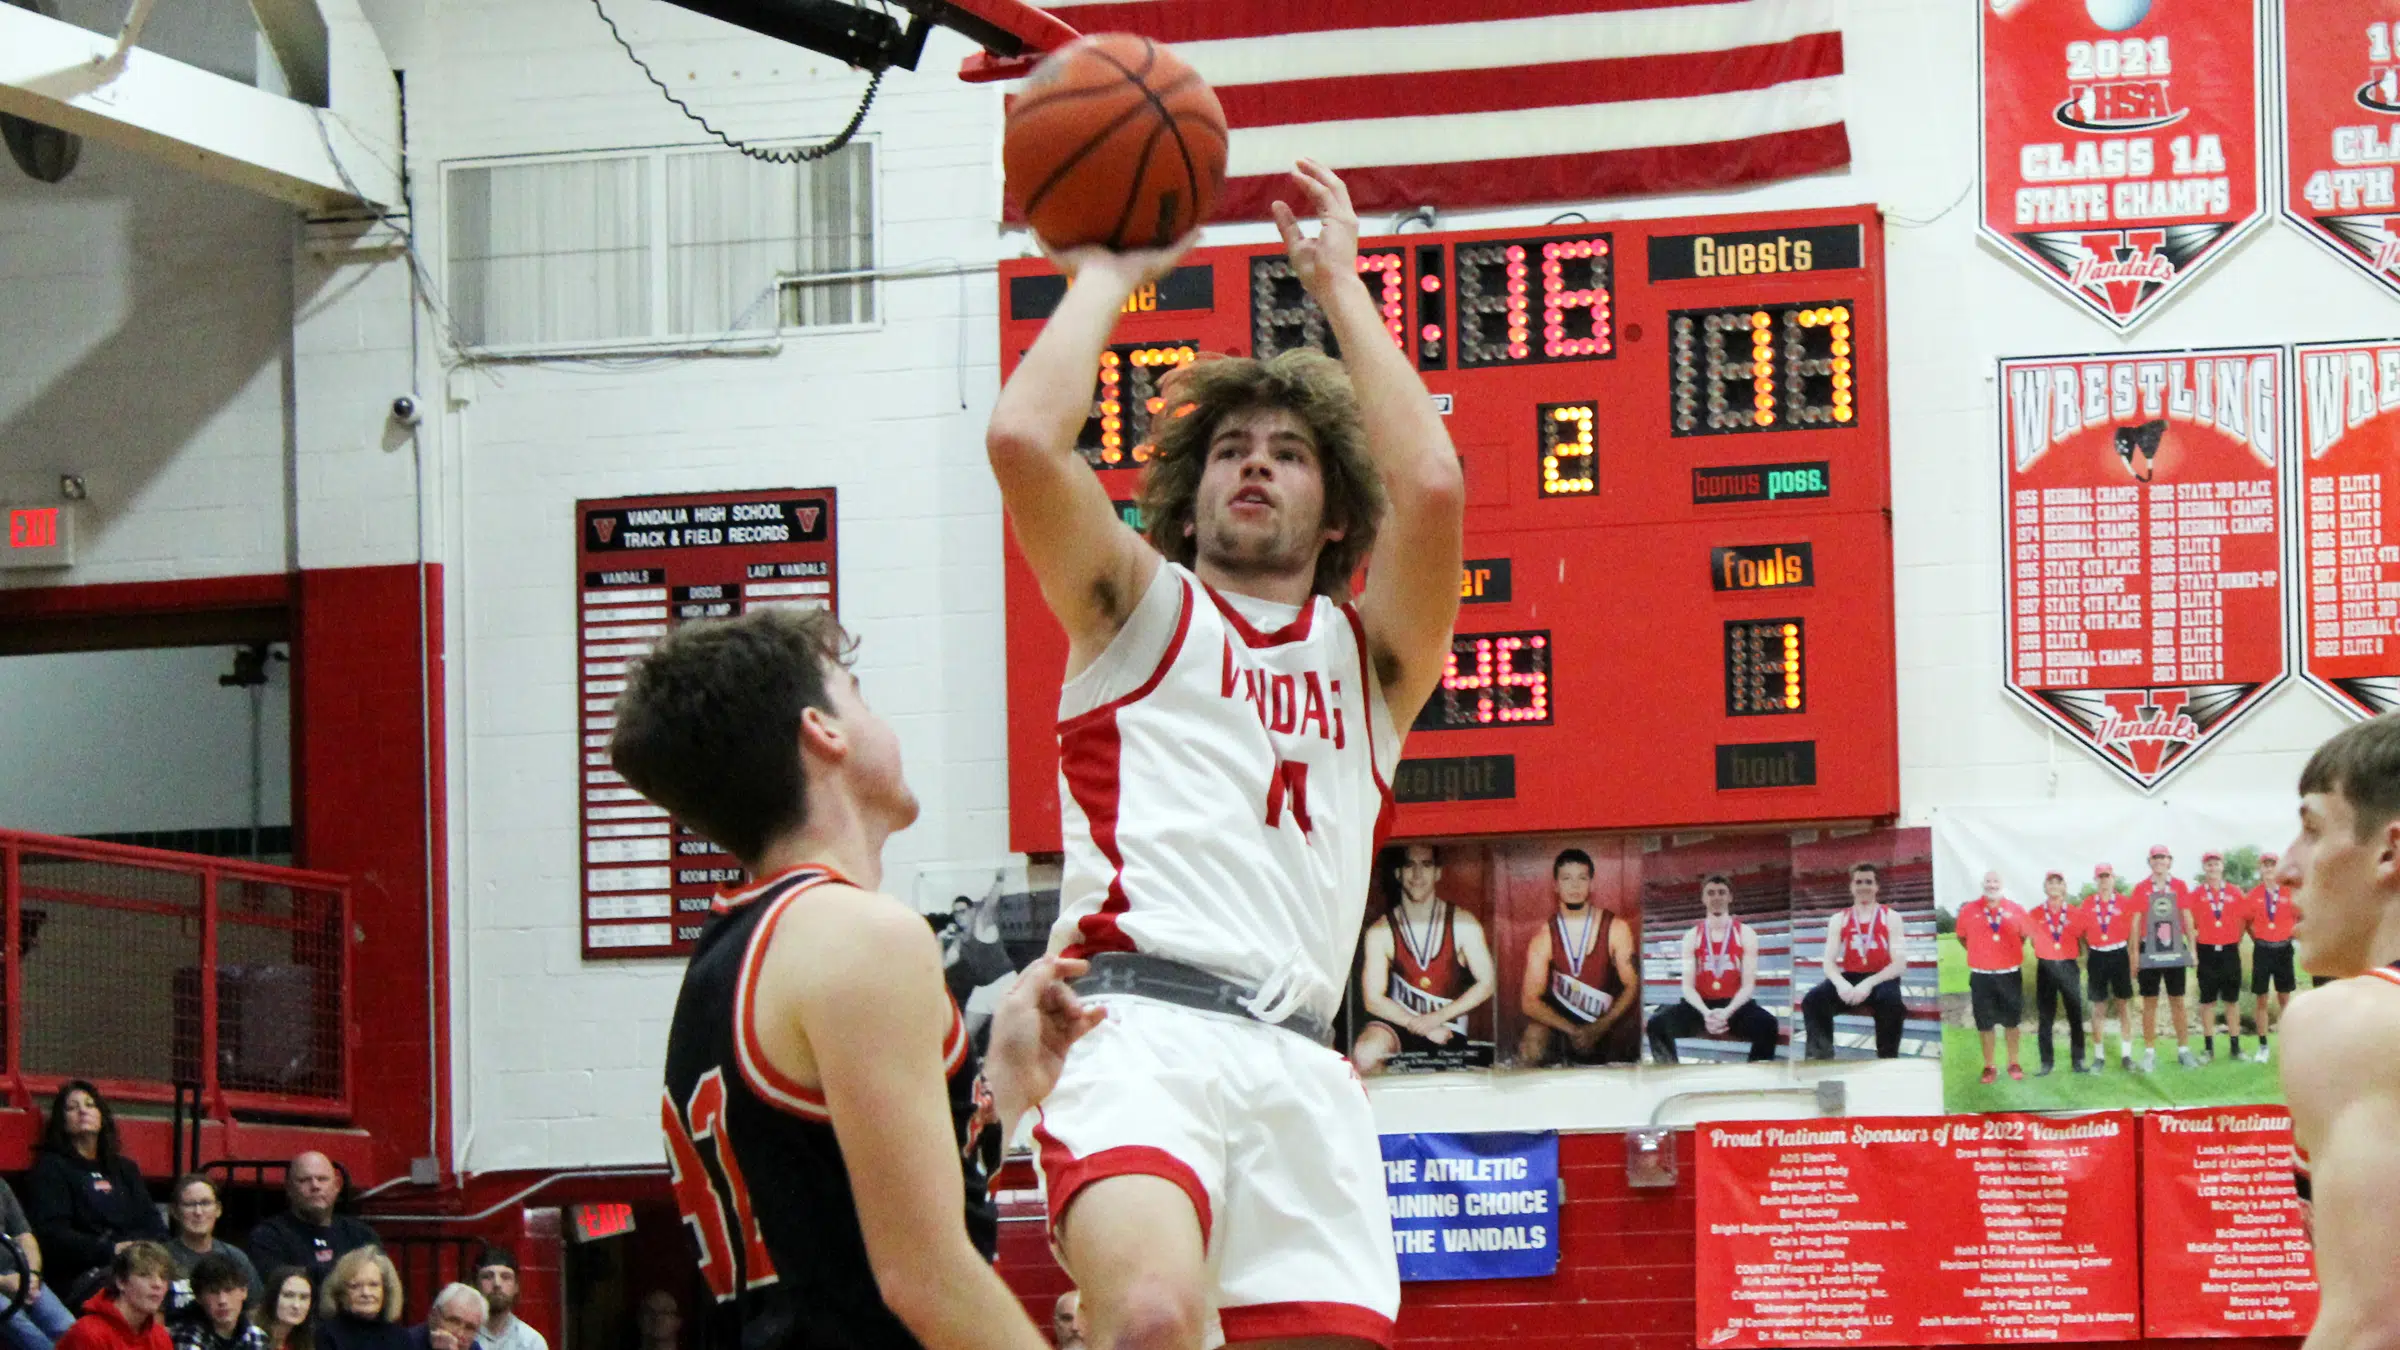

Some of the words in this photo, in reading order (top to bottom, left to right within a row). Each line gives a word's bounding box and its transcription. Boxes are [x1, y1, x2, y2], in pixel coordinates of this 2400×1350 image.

[2066, 36, 2170, 80] 2021
[2020, 137, 2154, 181] CLASS
[2170, 134, 2226, 173] 1A
[2304, 167, 2394, 210] 4TH
[2016, 183, 2108, 224] STATE
[2114, 177, 2229, 219] CHAMPS
[1694, 235, 1813, 276] Guests
[2070, 253, 2177, 287] Vandals
[1751, 305, 1853, 426] 17
[2010, 357, 2277, 473] WRESTLING
[1543, 405, 1594, 493] 2
[1695, 469, 1760, 497] bonus
[1768, 465, 1827, 500] poss.
[2178, 483, 2212, 499] STATE
[2238, 481, 2271, 496] PLACE
[2340, 474, 2371, 492] ELITE
[2097, 486, 2139, 502] CHAMPS
[2341, 494, 2371, 510] ELITE
[627, 507, 688, 526] VANDALIA
[694, 505, 726, 523] HIGH
[732, 504, 784, 522] SCHOOL
[2097, 505, 2139, 520] CHAMPS
[2232, 499, 2272, 515] CHAMPS
[10, 508, 59, 548] EXIT
[2232, 517, 2273, 533] CHAMPS
[2341, 512, 2371, 528] ELITE
[624, 531, 666, 548] TRACK
[670, 529, 680, 546] &
[684, 528, 722, 545] FIELD
[729, 525, 789, 543] RECORDS
[2098, 523, 2139, 538] CHAMPS
[2341, 530, 2372, 546] ELITE
[2098, 541, 2139, 556] CHAMPS
[2180, 538, 2210, 553] ELITE
[2180, 556, 2210, 571] ELITE
[2342, 548, 2375, 564] STATE
[747, 564, 774, 578] LADY
[779, 562, 827, 576] VANDALS
[1723, 547, 1803, 589] fouls
[2045, 561, 2079, 576] STATE
[2107, 559, 2140, 574] PLACE
[2342, 566, 2374, 583] ELITE
[601, 570, 650, 584] VANDALS
[2180, 574, 2214, 589] STATE
[689, 586, 723, 599] DISCUS
[2045, 579, 2080, 594] STATE
[2083, 578, 2124, 593] CHAMPS
[2342, 584, 2374, 600] STATE
[2045, 597, 2080, 612] STATE
[2108, 595, 2140, 610] PLACE
[2181, 592, 2212, 607] ELITE
[2182, 610, 2212, 625] ELITE
[2343, 602, 2374, 618] STATE
[2046, 615, 2080, 630] STATE
[2108, 613, 2141, 629] PLACE
[2047, 633, 2077, 648] ELITE
[2181, 628, 2212, 644] ELITE
[2182, 647, 2212, 662] ELITE
[2344, 639, 2374, 655] ELITE
[2100, 649, 2142, 665] CHAMPS
[1783, 623, 1800, 709] 1
[2182, 664, 2214, 680] ELITE
[1443, 635, 1547, 723] 45
[2047, 670, 2078, 684] ELITE
[2094, 713, 2199, 746] Vandals
[1731, 751, 1798, 786] bout
[710, 869, 740, 881] RELAY
[2158, 1115, 2214, 1133] Proud
[1710, 1128, 1763, 1148] Proud
[1765, 1127, 1847, 1147] Platinum
[1851, 1124, 1929, 1149] Sponsors
[1933, 1123, 1951, 1147] of
[1953, 1123, 1980, 1141] the
[1983, 1120, 2025, 1141] 2022
[1384, 1160, 1417, 1183] THE
[1424, 1157, 1528, 1182] ATHLETIC
[1389, 1193, 1459, 1219] AINING
[1465, 1189, 1548, 1216] CHOICE
[1394, 1229, 1436, 1254] THE
[1442, 1225, 1547, 1253] VANDALS
[1774, 1250, 1793, 1262] City
